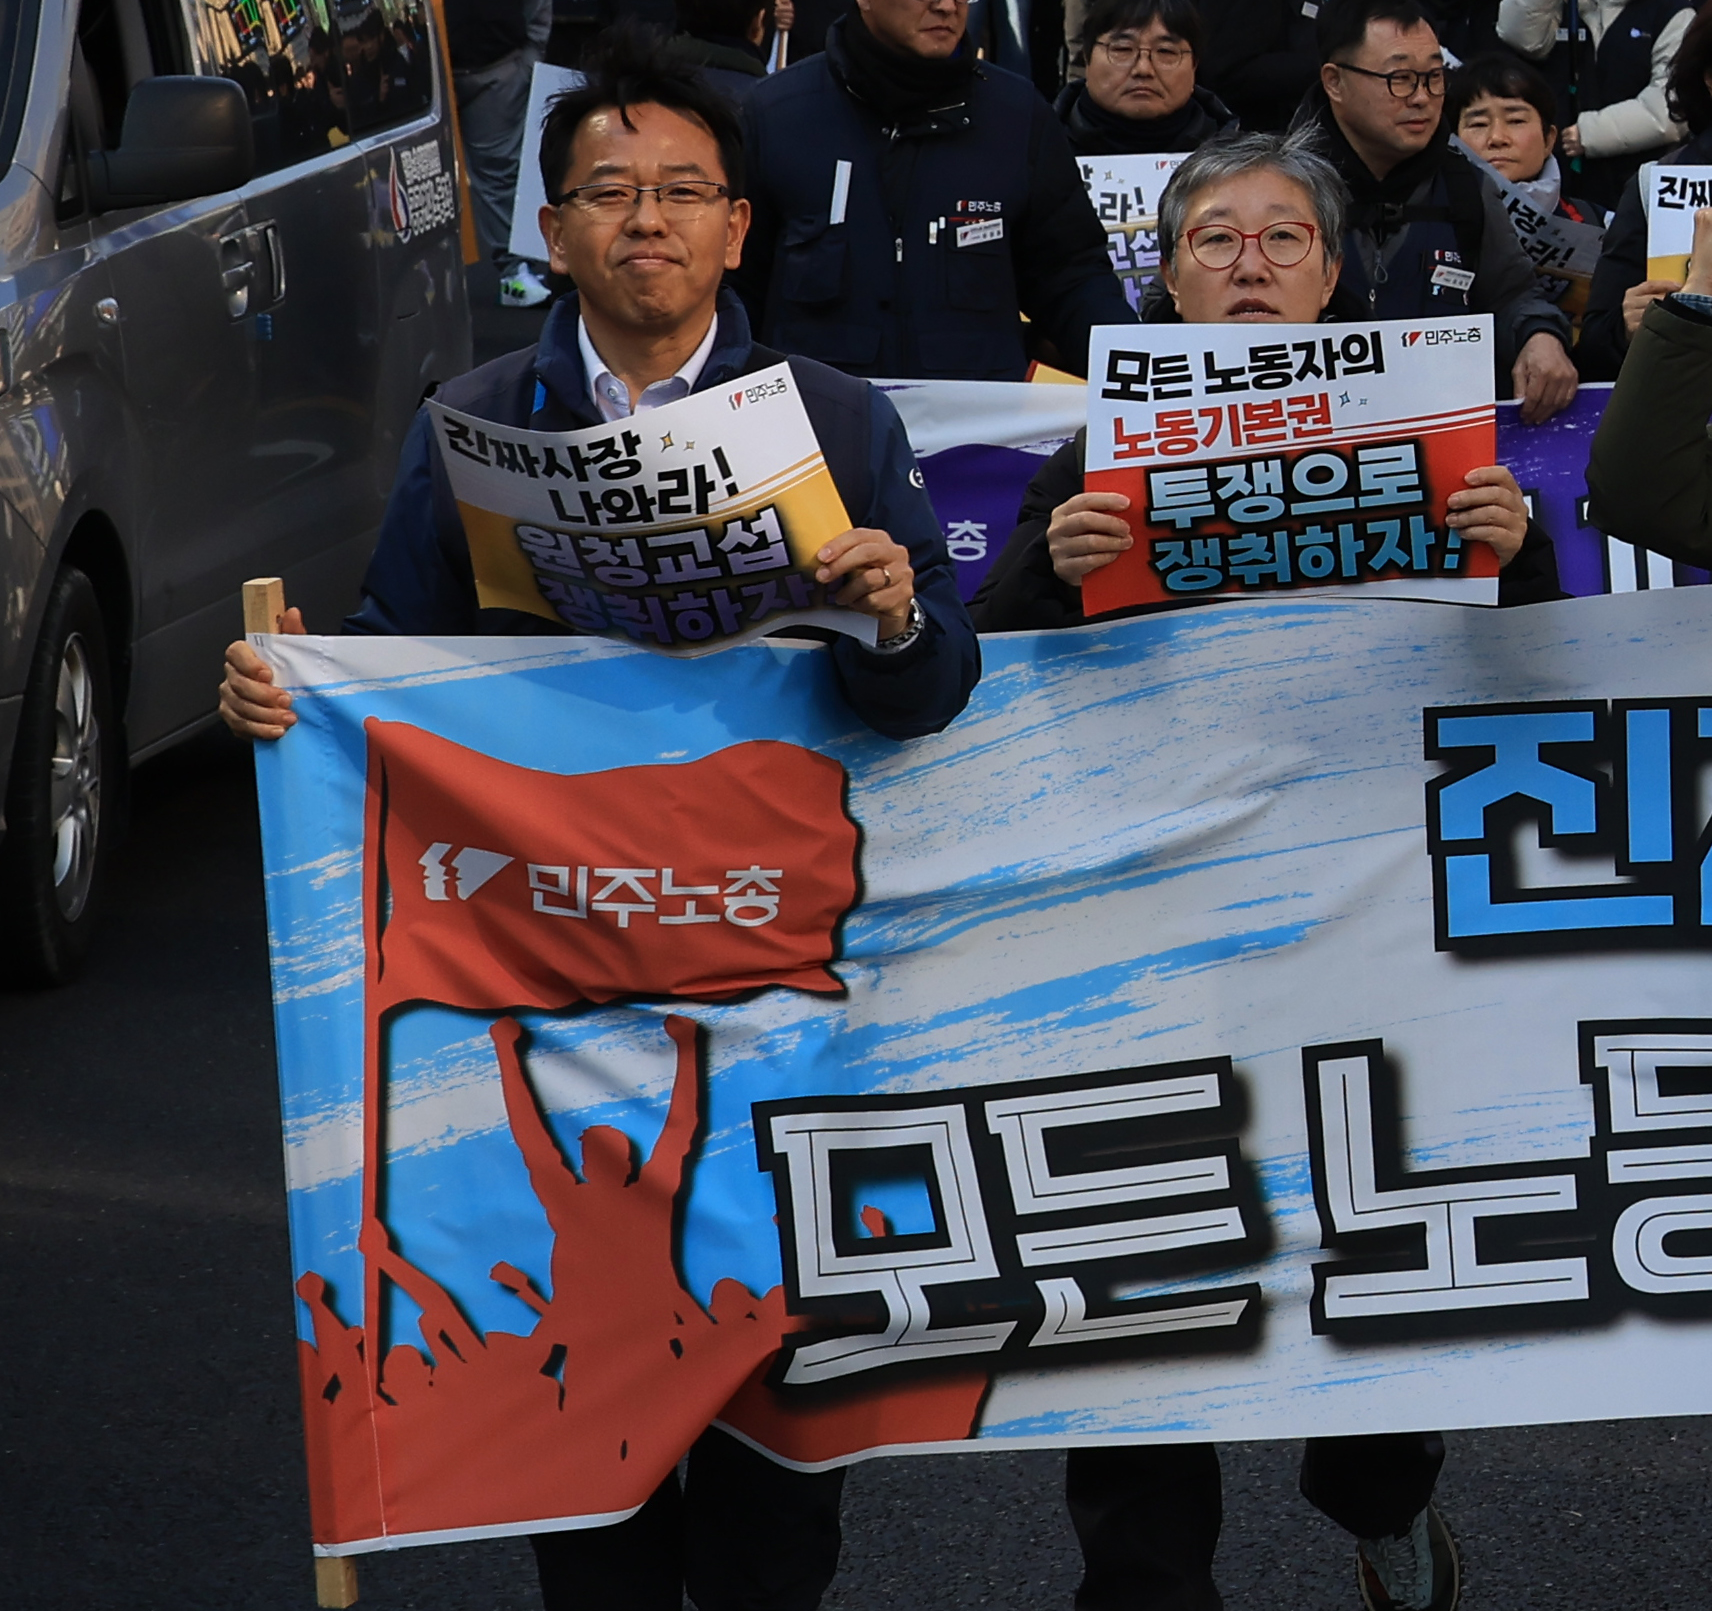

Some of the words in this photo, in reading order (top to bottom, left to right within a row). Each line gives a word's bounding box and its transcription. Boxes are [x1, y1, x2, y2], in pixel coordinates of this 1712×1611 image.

[968, 200, 1003, 213] 민주노총
[1101, 346, 1195, 404] 모든
[1203, 332, 1387, 396] 노동자의
[1424, 327, 1482, 346] 민주노총
[746, 377, 789, 408] 민주노총
[1112, 391, 1334, 460] 노동기본권
[442, 411, 643, 486] 진짜사장
[553, 446, 741, 528] 나와라!
[1148, 446, 1423, 530] 투쟁으로
[515, 505, 789, 587] 원청교섭
[1154, 515, 1462, 592] 쟁취하자!
[526, 864, 784, 930] 민주노총
[757, 1058, 1269, 1392] 모든
